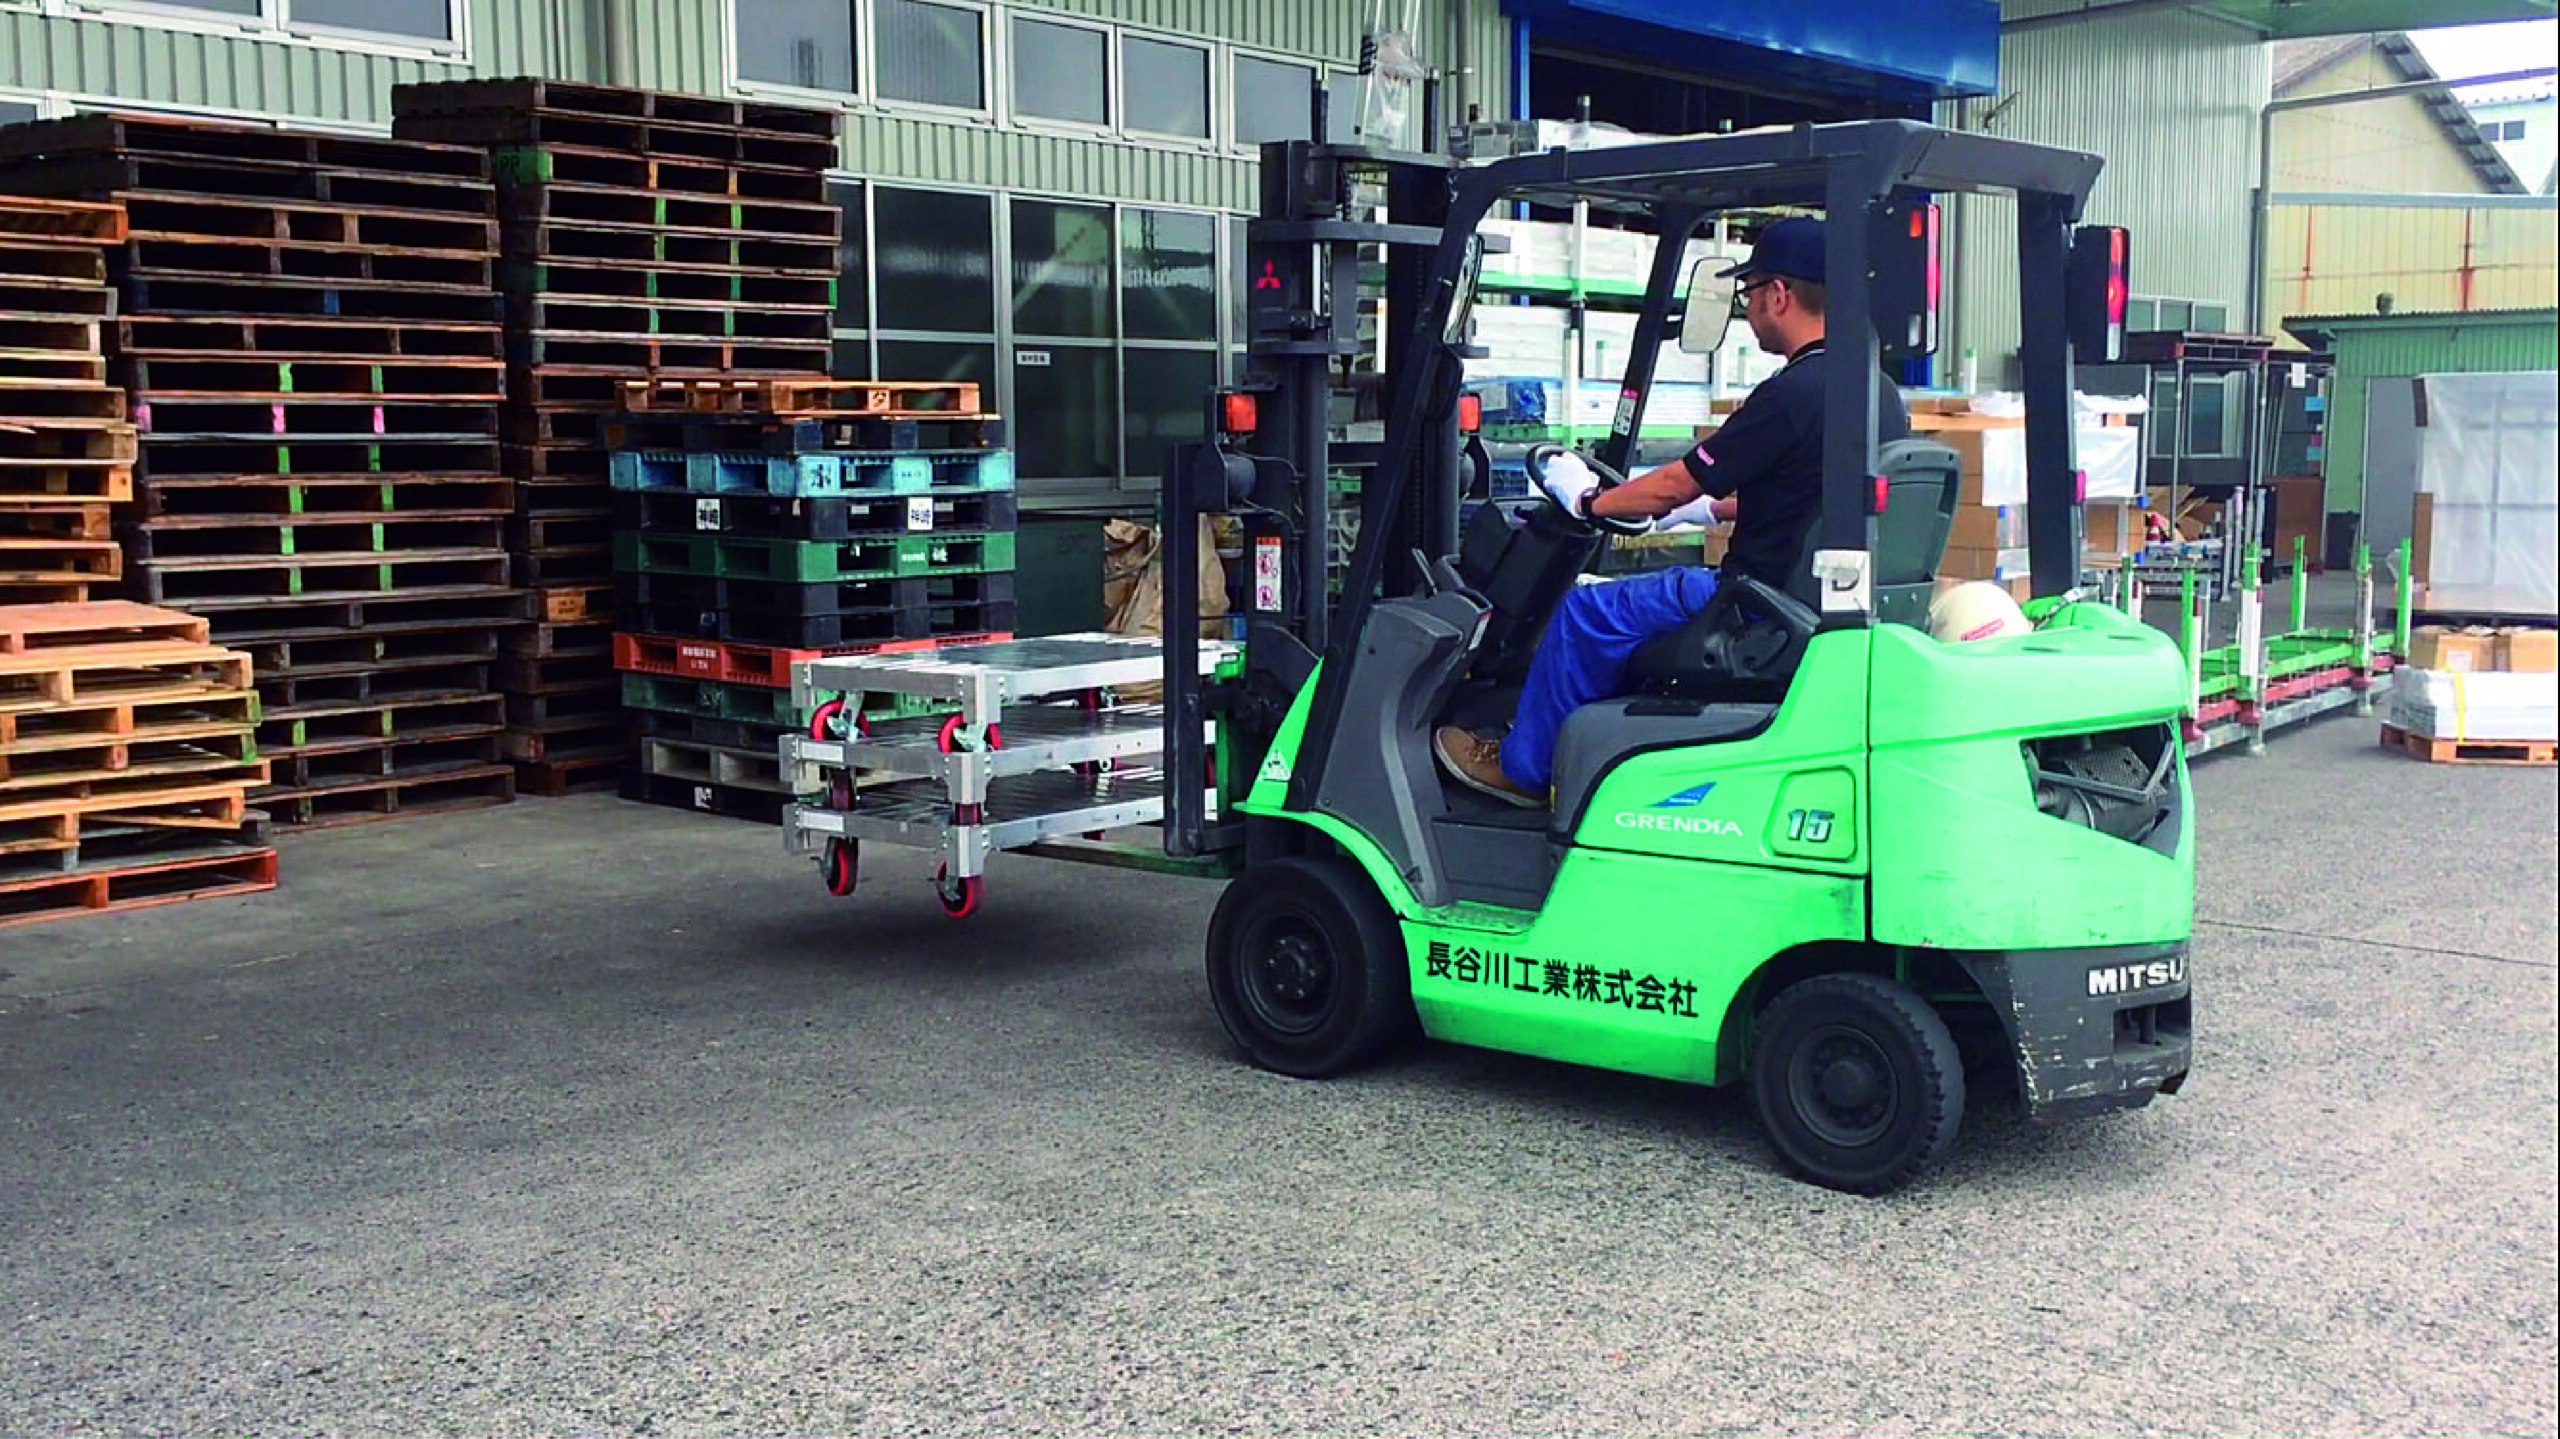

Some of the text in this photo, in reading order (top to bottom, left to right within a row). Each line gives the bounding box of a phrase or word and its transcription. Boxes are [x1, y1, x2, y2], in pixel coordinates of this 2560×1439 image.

[1615, 812, 1744, 837] GRENDIA
[1788, 808, 1835, 842] 15
[1426, 940, 1699, 1018] 長谷川工業株式会社
[2087, 957, 2184, 995] MITSU
